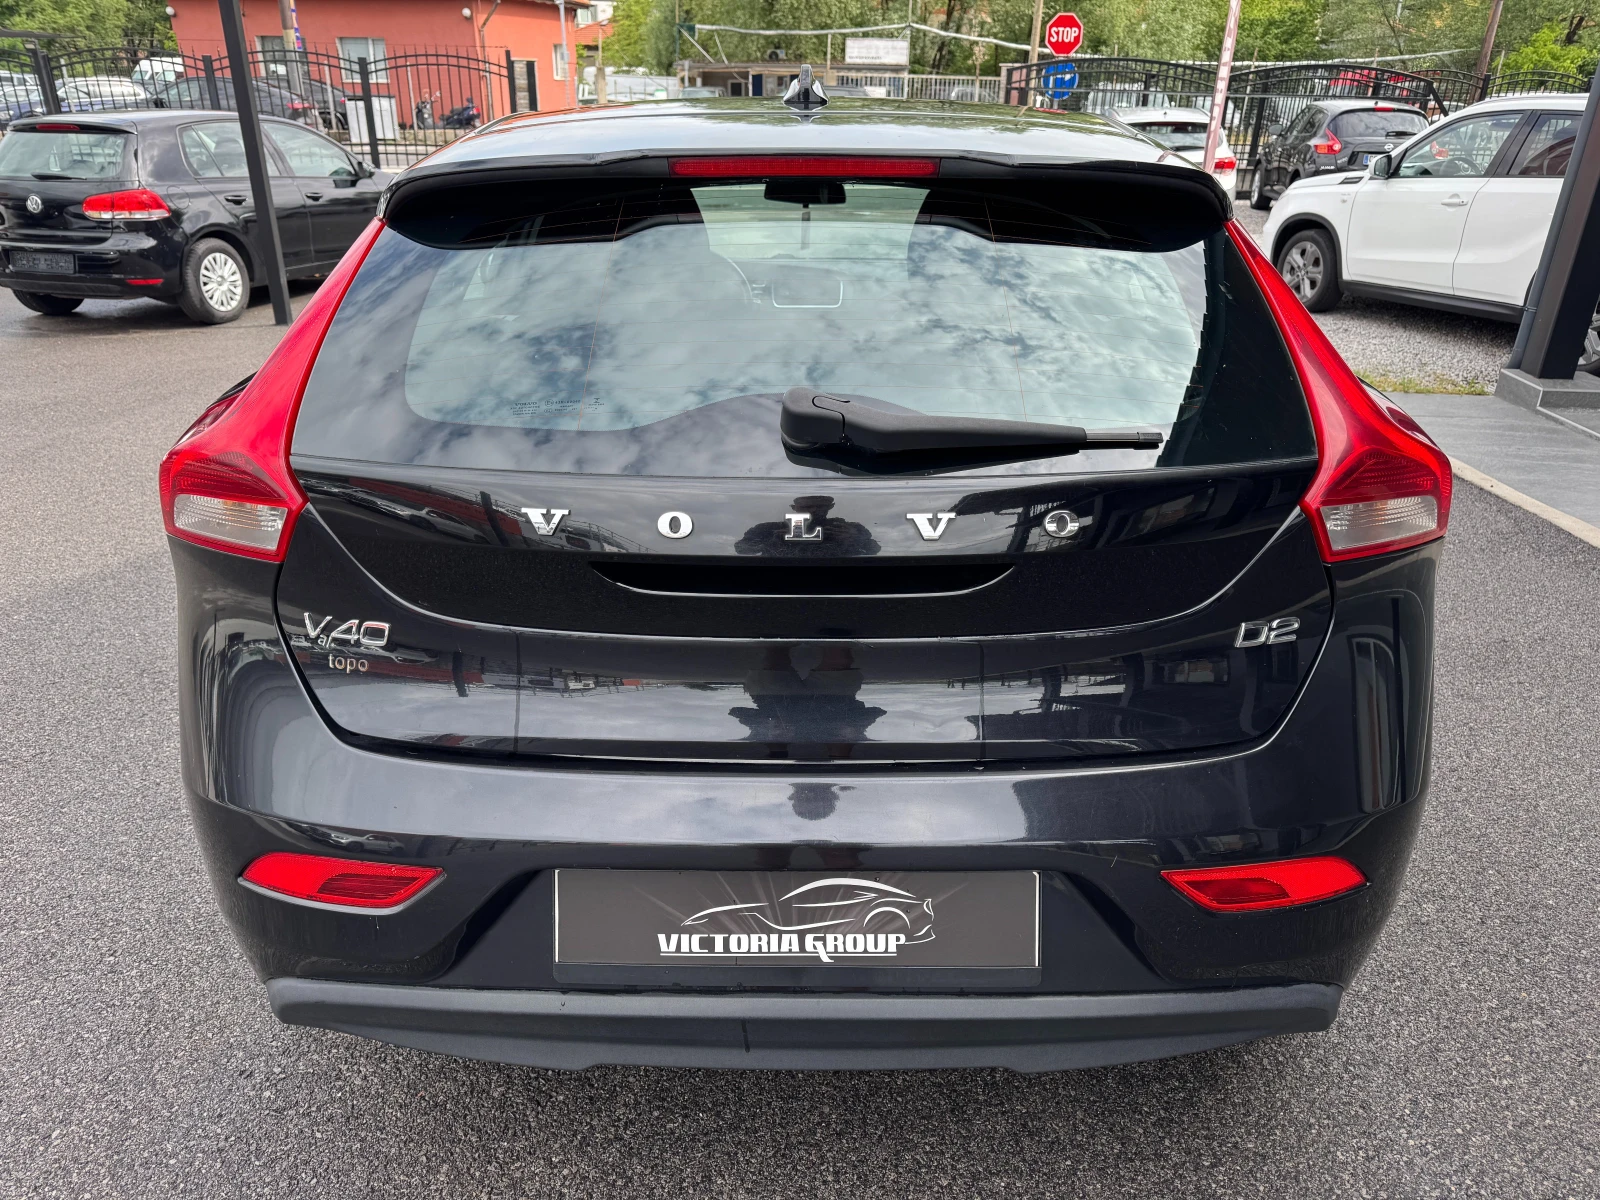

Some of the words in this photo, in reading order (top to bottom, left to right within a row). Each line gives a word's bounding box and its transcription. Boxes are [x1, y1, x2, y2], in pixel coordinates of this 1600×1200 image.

[1050, 27, 1079, 42] STOP
[521, 507, 1079, 541] VOLVO
[303, 612, 391, 647] V40
[1234, 616, 1300, 648] D2
[328, 653, 369, 674] topo
[657, 933, 800, 953] VICTORIA
[804, 933, 906, 962] GROUP
